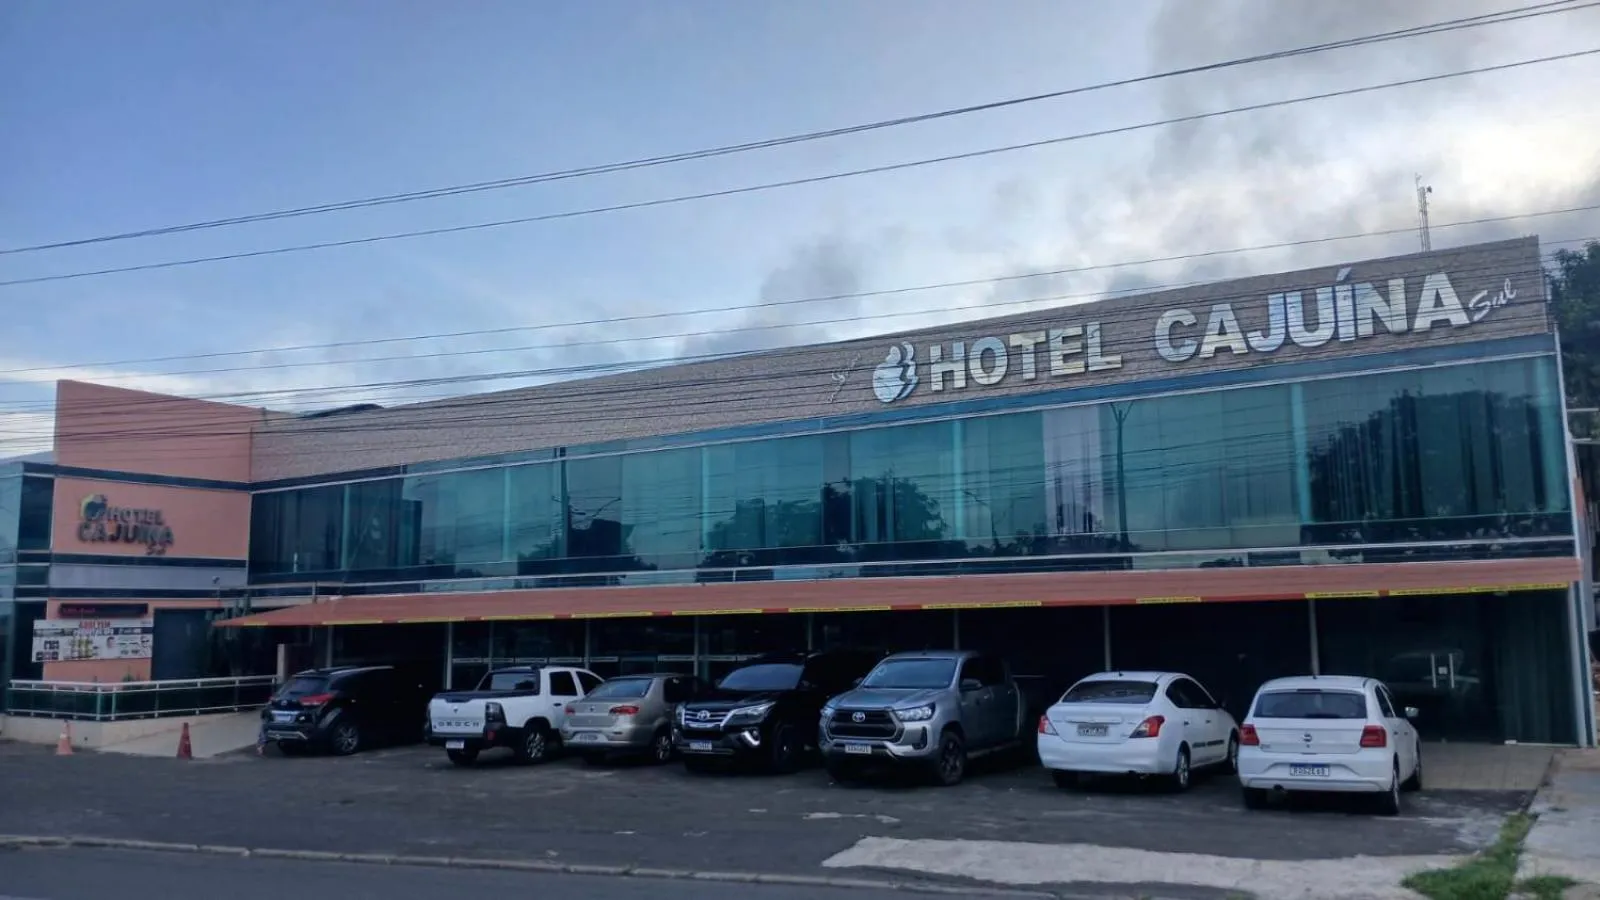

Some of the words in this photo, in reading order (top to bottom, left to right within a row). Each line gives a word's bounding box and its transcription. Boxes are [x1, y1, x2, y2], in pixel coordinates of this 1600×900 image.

[1468, 278, 1518, 322] Sul
[930, 322, 1122, 391] HOTEL
[1155, 267, 1470, 362] CAJUÍNA
[106, 506, 164, 526] HOTEL
